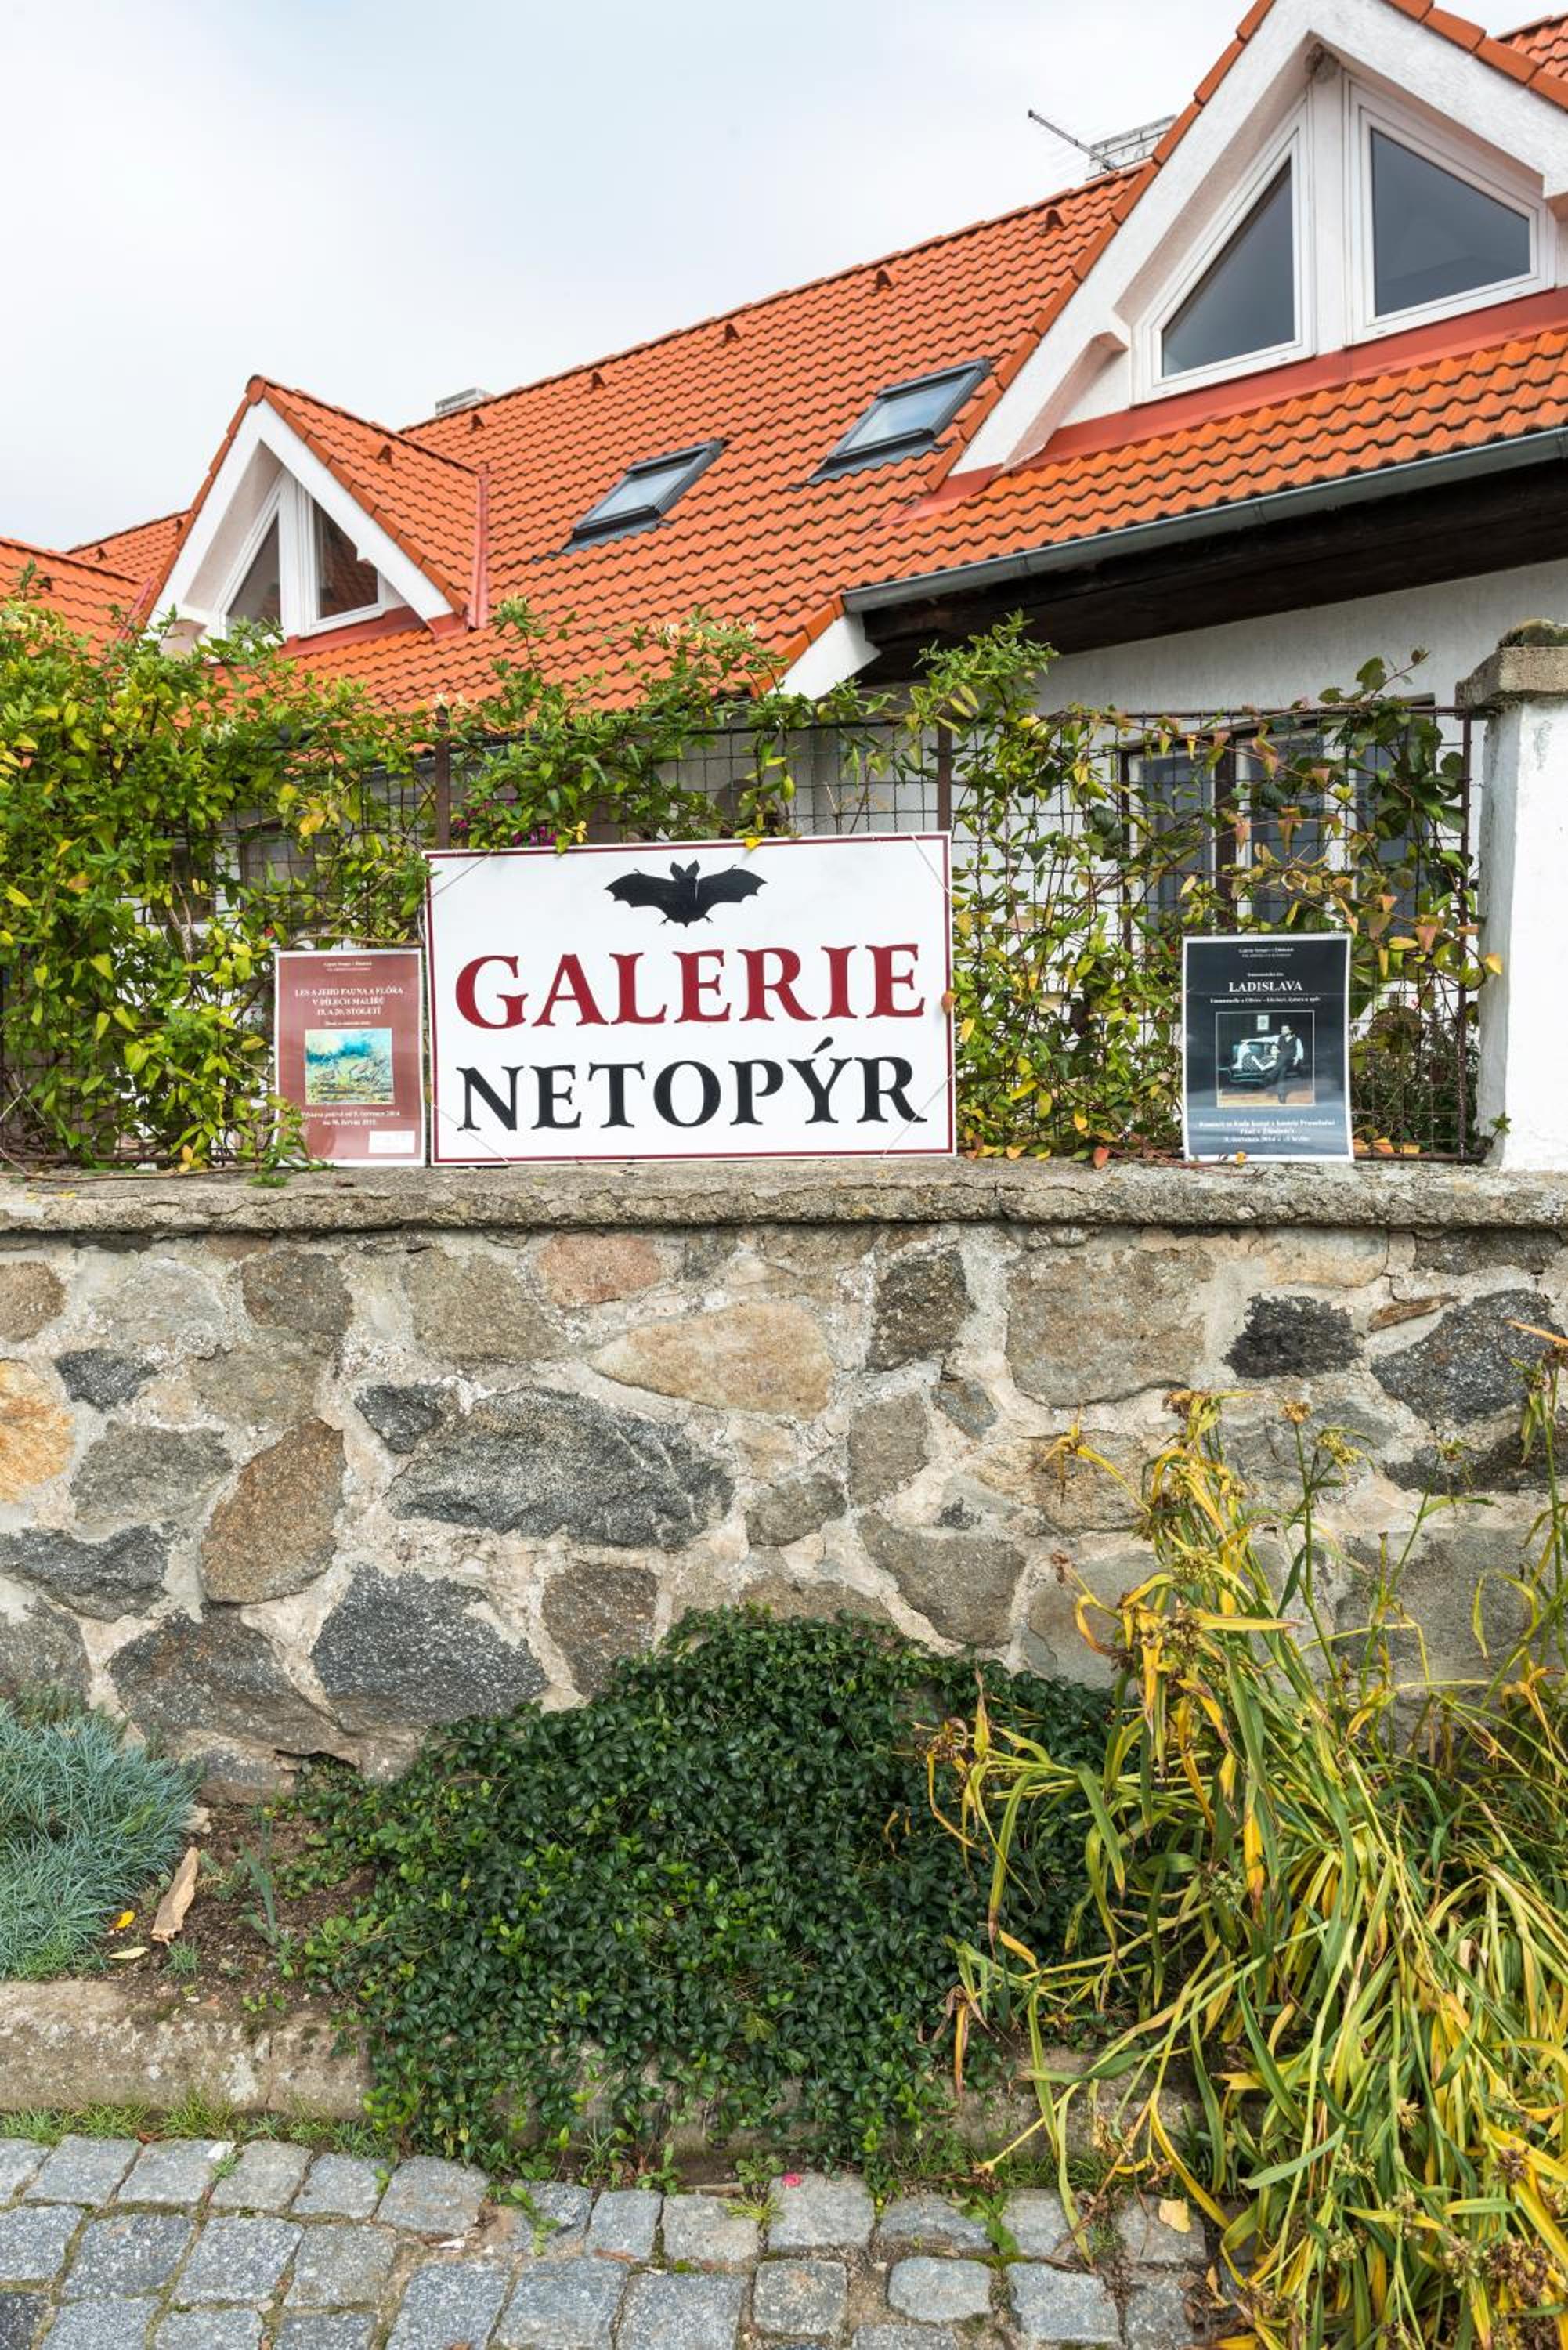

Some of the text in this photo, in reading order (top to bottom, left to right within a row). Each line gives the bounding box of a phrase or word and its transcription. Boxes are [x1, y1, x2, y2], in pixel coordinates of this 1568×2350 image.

[341, 987, 367, 996] FAUNA
[455, 942, 925, 1029] GALERIE
[1229, 979, 1302, 992] LADISLAVA
[457, 1036, 927, 1131] NETOPÝR
